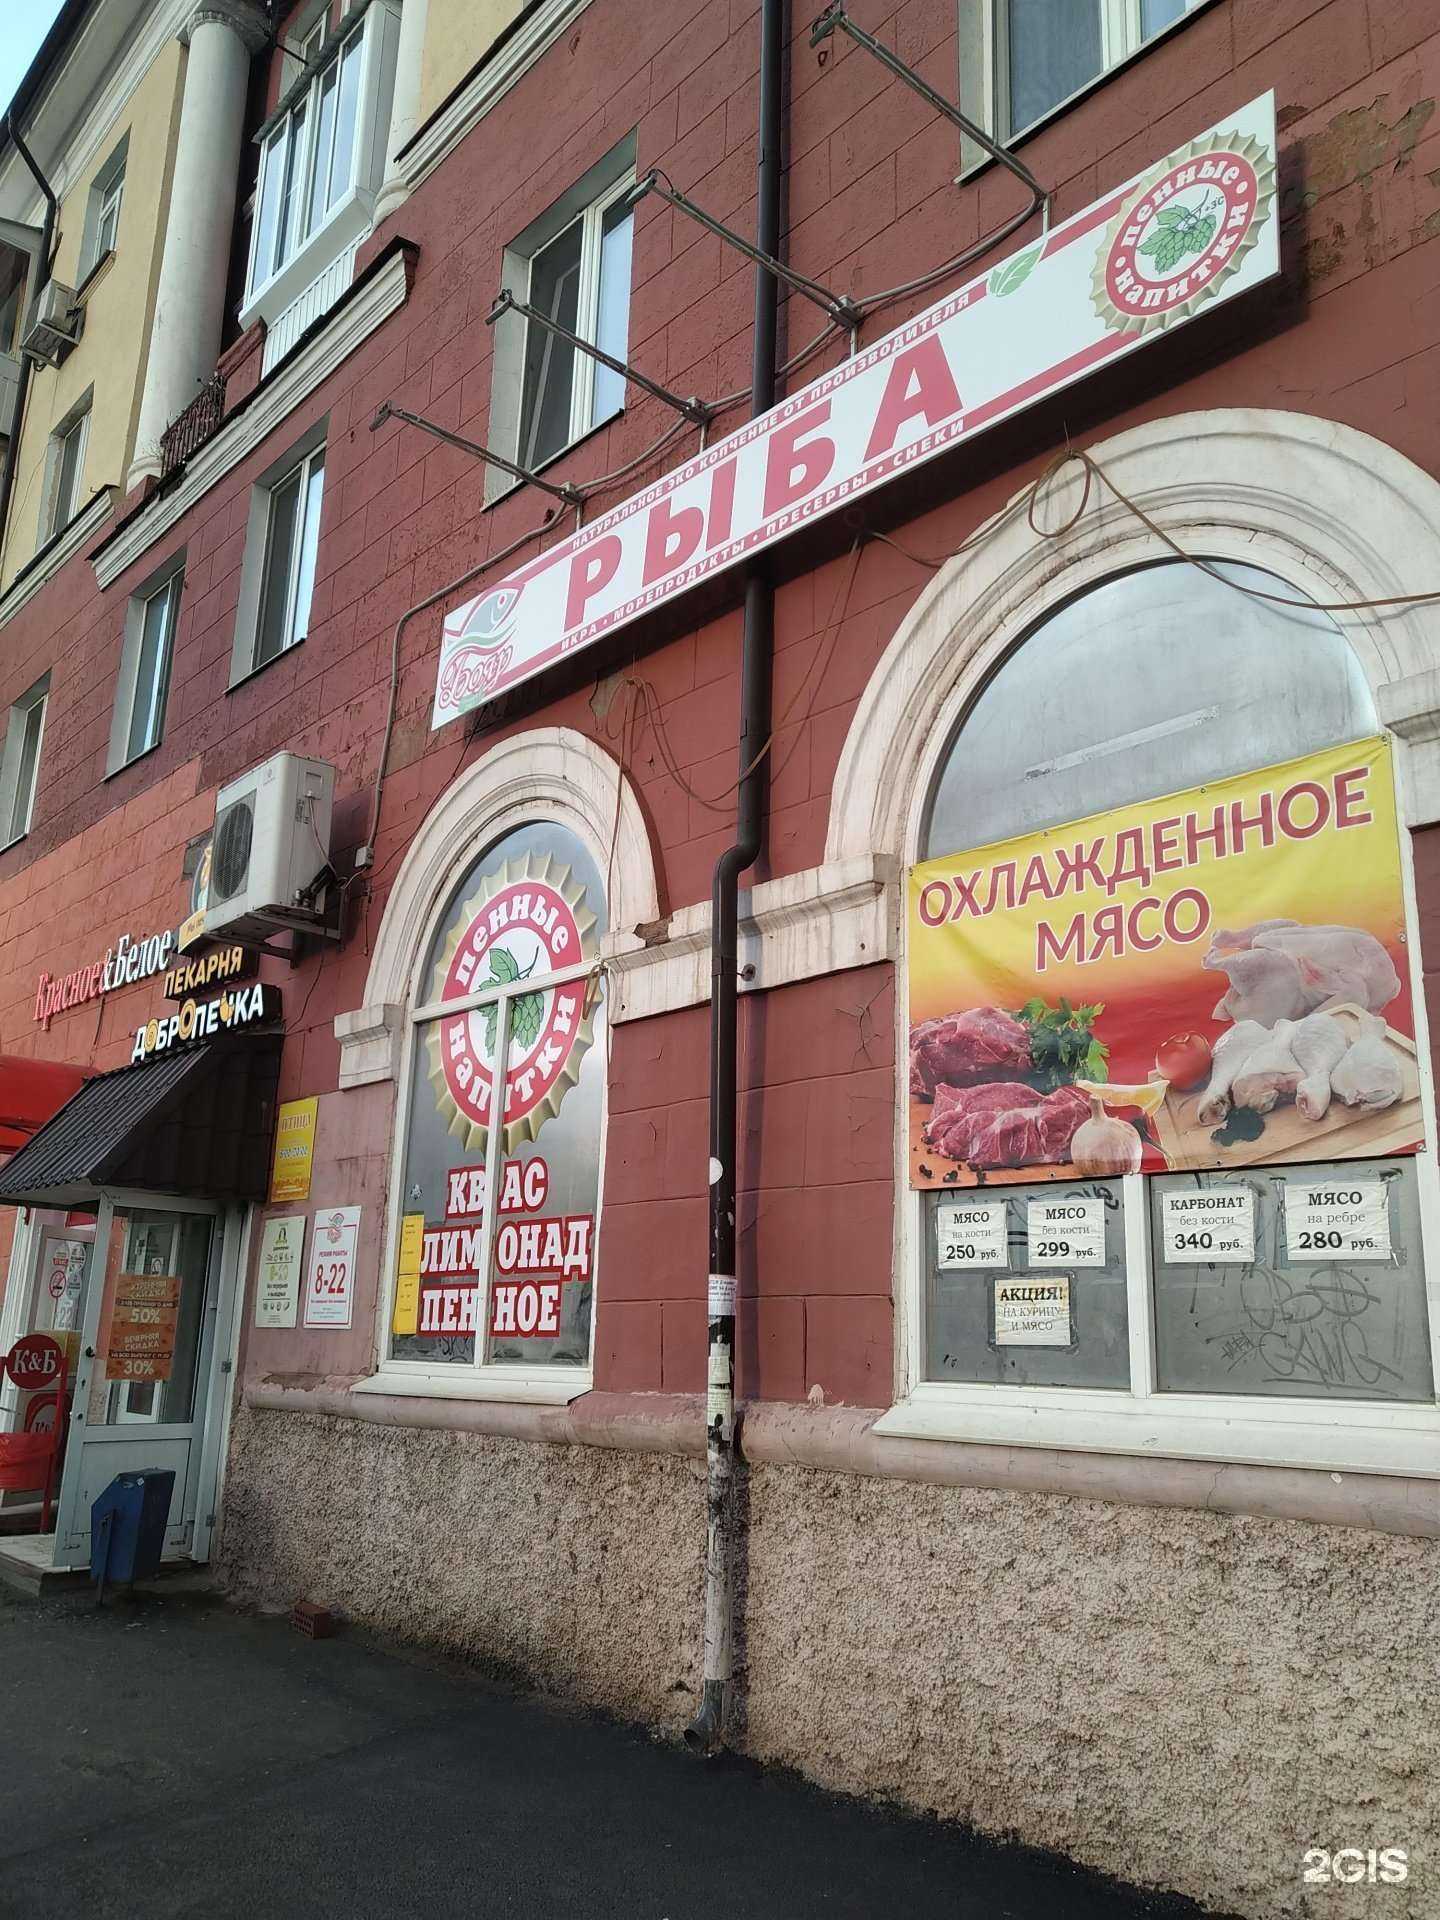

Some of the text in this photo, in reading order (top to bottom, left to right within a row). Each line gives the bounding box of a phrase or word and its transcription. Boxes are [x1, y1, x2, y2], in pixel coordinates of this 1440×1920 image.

[573, 293, 970, 550] НАТУРАЛЬНОЕ ЭКО КОПЧЕНИЕ ОТ ПРОИЗВОДИТЕЛЯ
[563, 332, 964, 634] РЫБА
[560, 418, 965, 652] ИКРА МОРЕПРОДУКТЫ ПРЕСЕРВЫ СНЕКИ
[918, 767, 1373, 927] ОХЛАЖДЕННОЕ
[1036, 887, 1211, 972] МЯСО
[163, 946, 244, 998] ПЕКАРНЯ
[447, 1161, 546, 1215] КВАС
[1170, 1196, 1245, 1211] КАРБОНАТ
[1308, 1191, 1363, 1206] МЯСО
[953, 1211, 990, 1225] МЯСО
[1045, 1207, 1086, 1220] МЯСО
[1180, 1215, 1235, 1226] без кости
[1307, 1211, 1366, 1226] на ребре
[952, 1230, 992, 1239] на кости
[1042, 1225, 1090, 1235] без кости
[420, 1219, 591, 1276] ЛИМОНАД
[1174, 1232, 1244, 1251] 340 руб.
[1298, 1231, 1379, 1251] 280 руб.
[946, 1244, 1000, 1261] 250 руб.
[1037, 1241, 1097, 1259] 299 руб.
[315, 1262, 347, 1295] 8-22
[1000, 1286, 1063, 1303] АКЦИЯ!
[130, 1308, 161, 1323] 50%
[420, 1284, 560, 1333] ПЕННОЕ
[1003, 1306, 1018, 1317] НА
[1011, 1321, 1053, 1331] И МЯСО
[12, 1349, 57, 1374] К&Б
[123, 1360, 154, 1375] 30%
